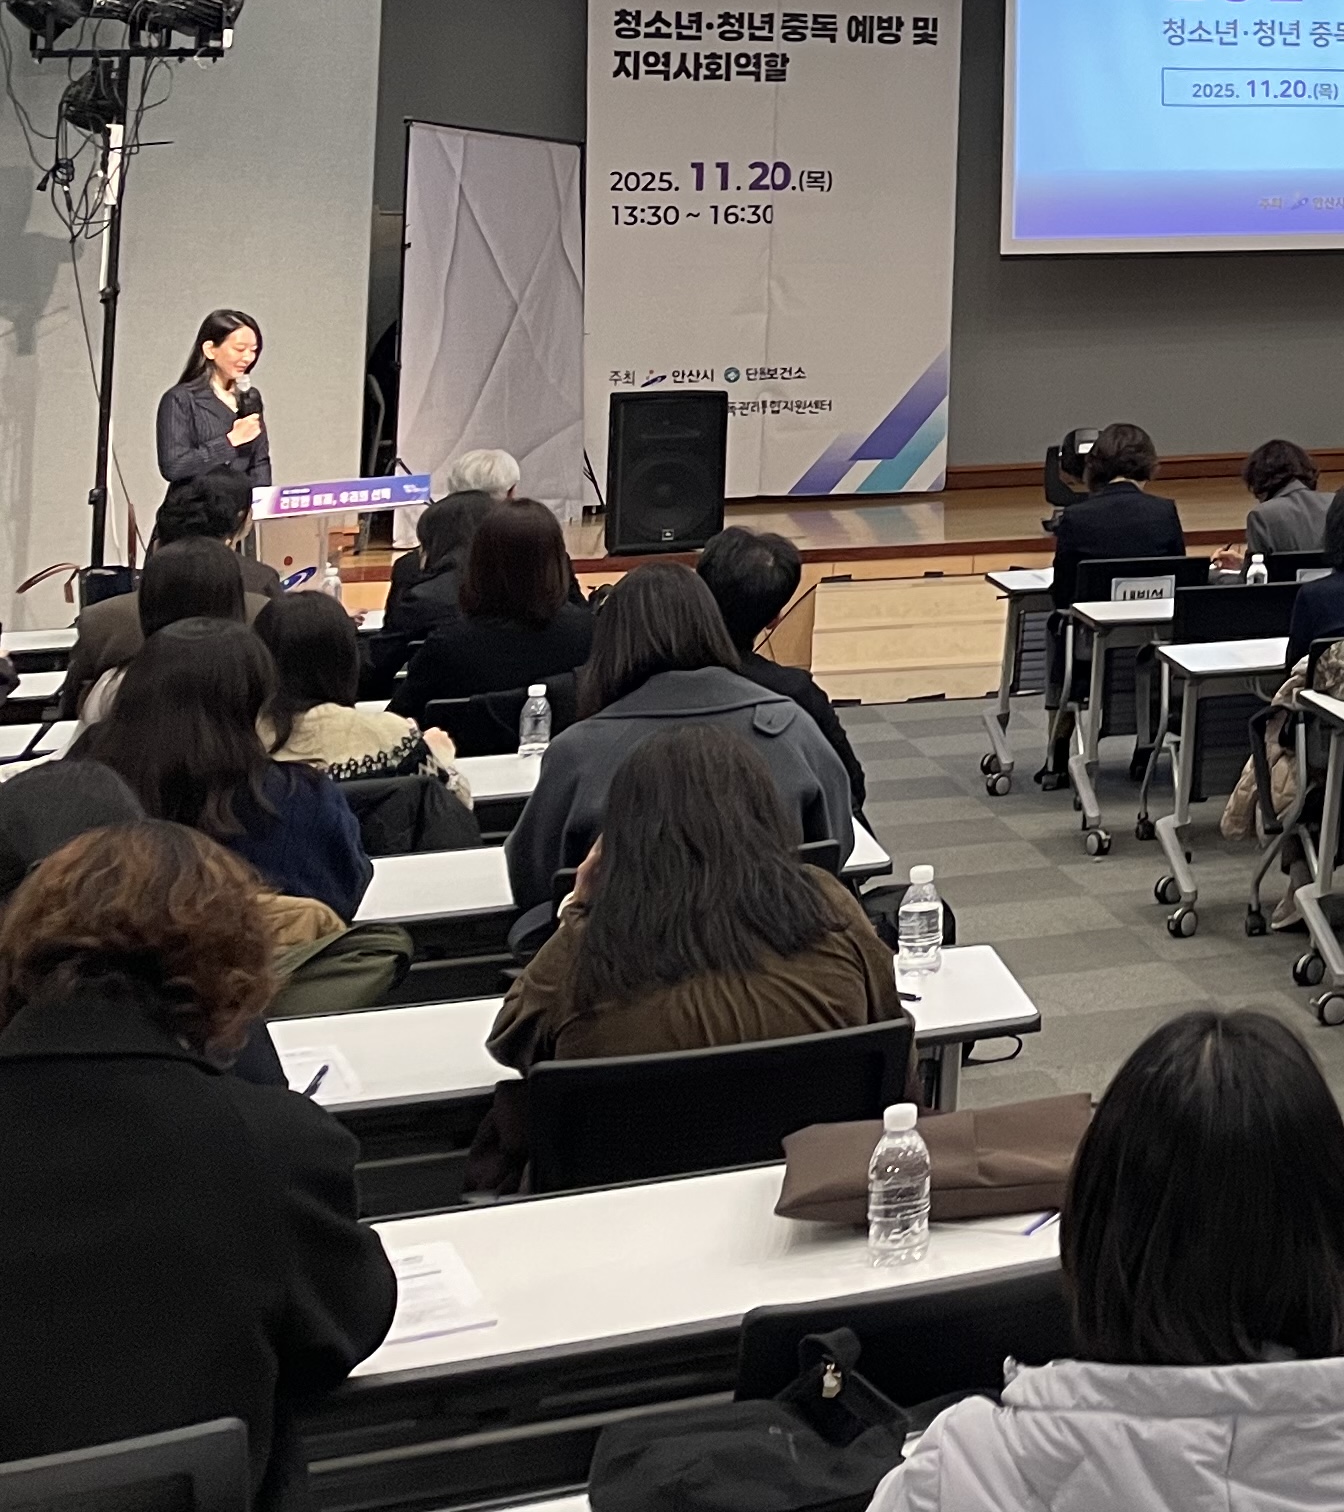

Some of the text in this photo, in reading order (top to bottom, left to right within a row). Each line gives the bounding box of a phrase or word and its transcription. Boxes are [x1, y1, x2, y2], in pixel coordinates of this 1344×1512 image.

[613, 9, 939, 46] 청소년·청년 중독 예방 및
[1162, 18, 1303, 48] 청소년·청년
[612, 49, 790, 83] 지역사회역할
[1192, 82, 1241, 101] 2025.
[1246, 79, 1339, 102] 11.20.(목)
[609, 171, 681, 193] 2025.
[611, 204, 680, 226] 13:30
[709, 204, 773, 226] 16:30
[609, 369, 636, 387] 주최
[671, 368, 715, 384] 안산시
